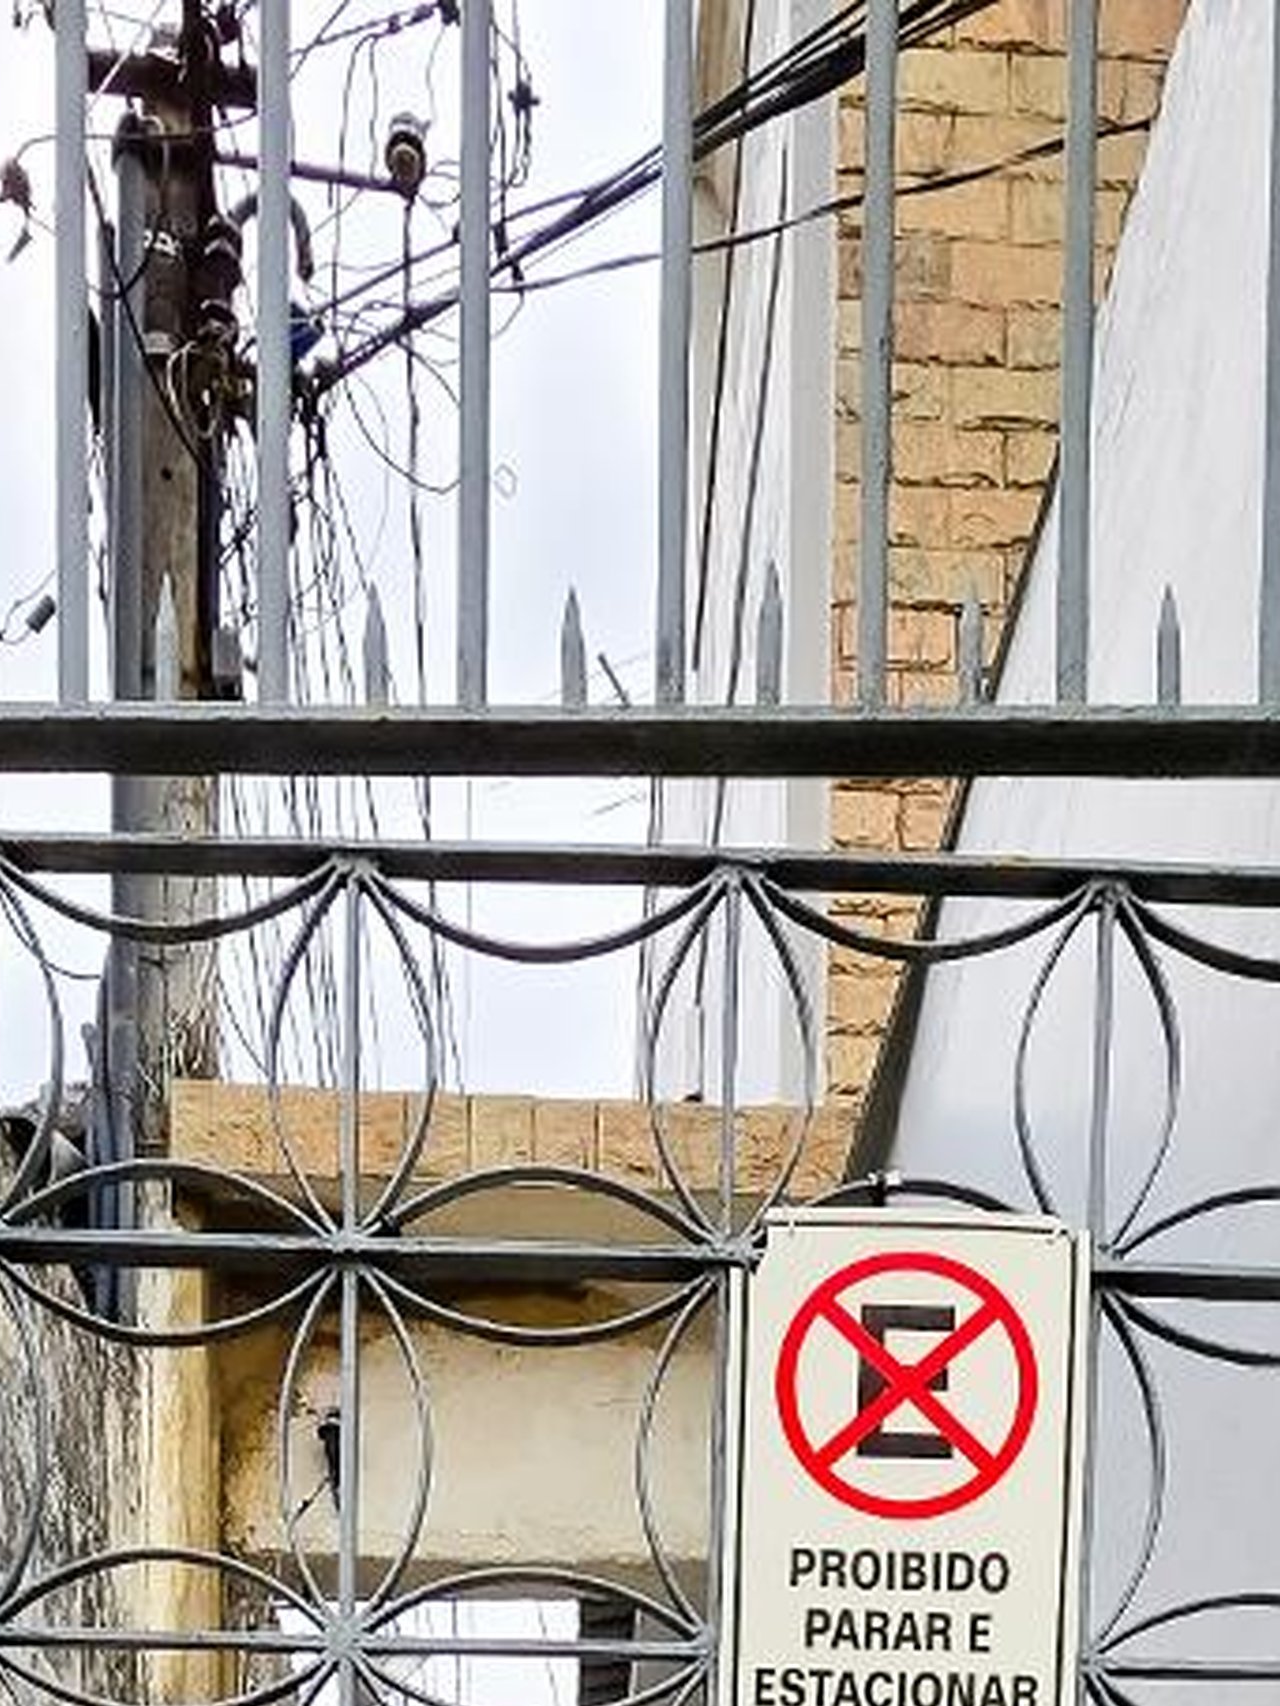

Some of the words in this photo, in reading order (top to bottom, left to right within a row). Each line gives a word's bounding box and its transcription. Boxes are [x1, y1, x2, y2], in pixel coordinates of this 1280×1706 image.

[789, 1548, 1010, 1594] PROIBIDO
[805, 1608, 952, 1651] PARAR
[969, 1613, 993, 1653] E
